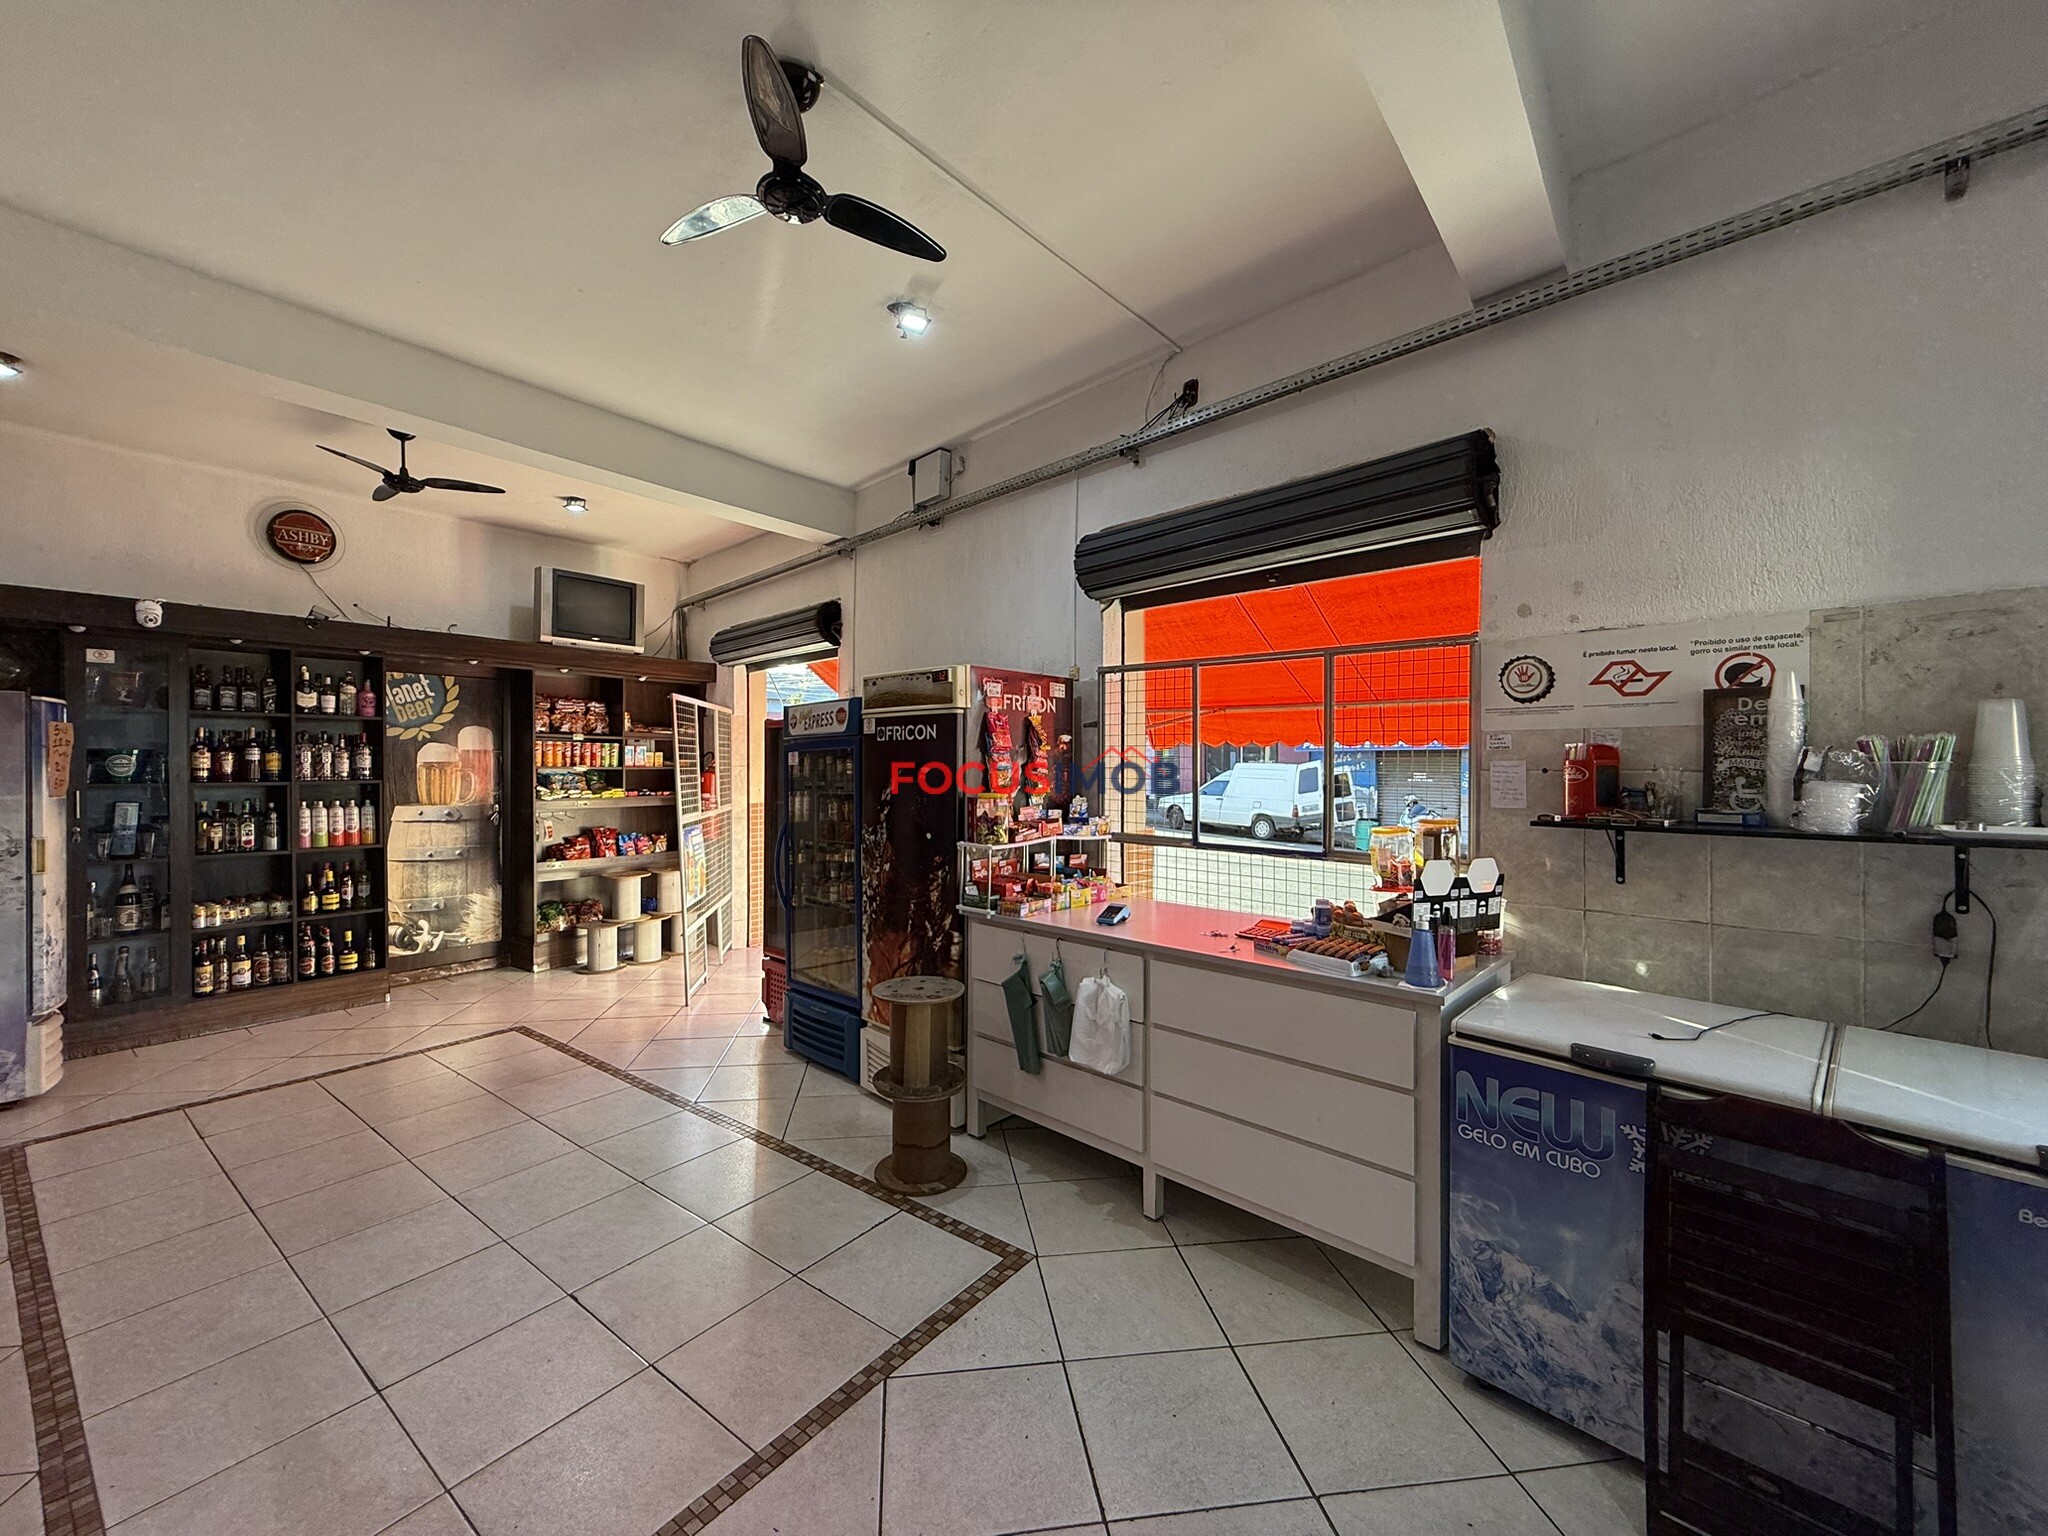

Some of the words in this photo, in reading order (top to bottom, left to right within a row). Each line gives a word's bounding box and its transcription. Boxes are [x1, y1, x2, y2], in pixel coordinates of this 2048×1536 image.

[278, 529, 328, 546] ASHBY
[1588, 648, 1616, 659] proibido
[1616, 647, 1637, 657] fumar
[1638, 646, 1659, 654] neste
[1659, 644, 1679, 652] local.
[1690, 647, 1711, 656] gorro
[1725, 644, 1751, 652] similar
[386, 674, 436, 708] lanet
[392, 697, 434, 723] beer
[1003, 694, 1057, 713] FRiON
[804, 710, 834, 731] EXPRESS
[1729, 759, 1751, 767] MAIS
[1456, 1070, 1616, 1161] NEW
[1458, 1124, 1507, 1150] GELO
[1512, 1140, 1541, 1162] EM
[1546, 1150, 1602, 1179] CUBO
